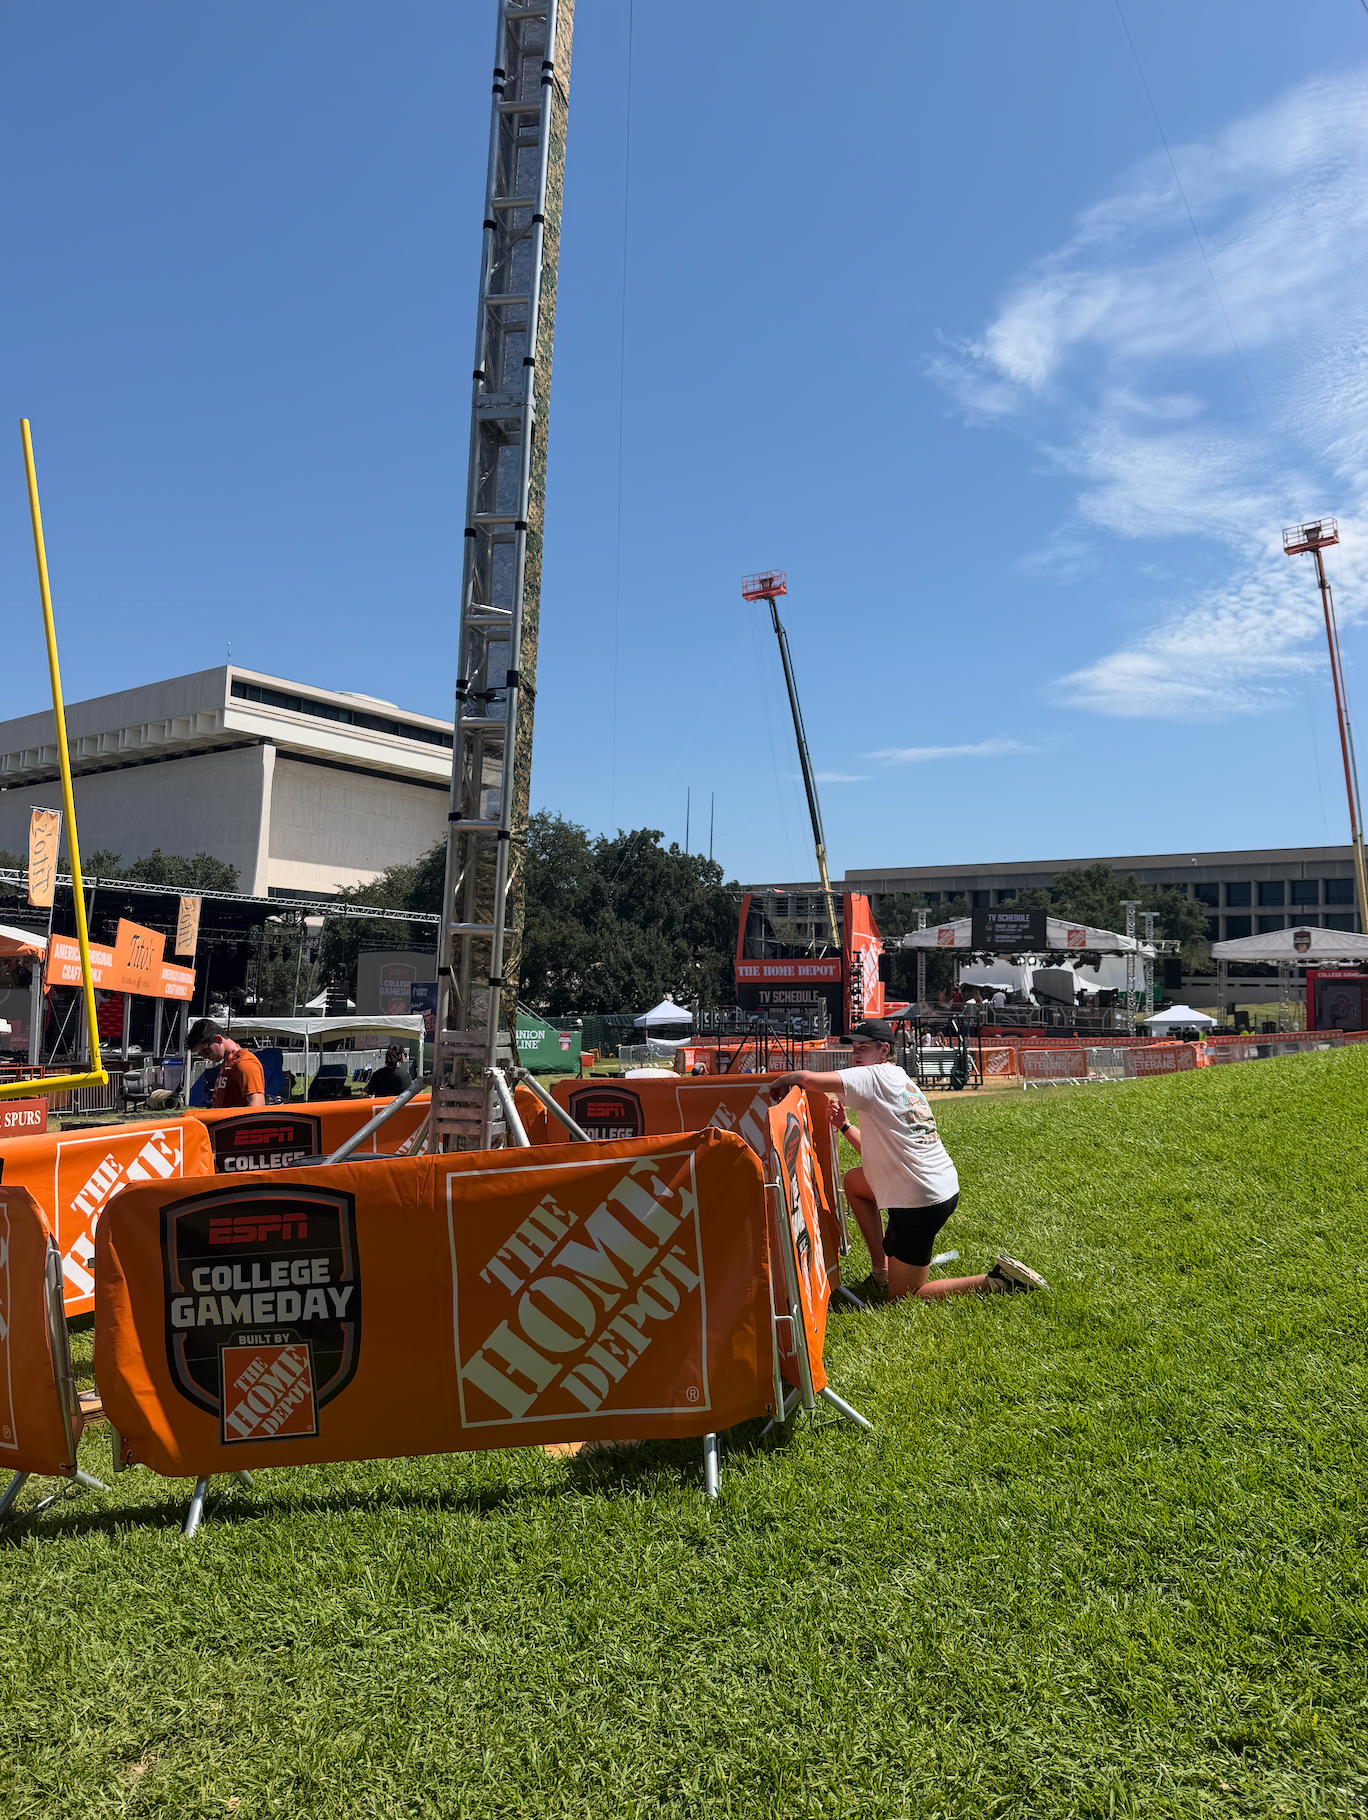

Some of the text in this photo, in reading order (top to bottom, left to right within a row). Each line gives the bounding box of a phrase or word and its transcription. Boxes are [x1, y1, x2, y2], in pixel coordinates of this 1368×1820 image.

[988, 914, 1030, 922] TV SCHEDULE
[127, 932, 154, 972] Tito's
[737, 965, 835, 977] THE HOME DEPOT
[379, 987, 411, 996] GAMEDA
[759, 990, 819, 1003] TV SCHEDULE
[1128, 1060, 1176, 1071] VETERANS
[1146, 1053, 1162, 1061] MORE
[1164, 1052, 1175, 1060] FOR
[4, 1110, 41, 1127] SPURS
[587, 1103, 625, 1117] ESPN
[234, 1127, 294, 1145] ESPN
[70, 1153, 124, 1217] THE
[209, 1213, 308, 1245] ESPN
[479, 1193, 580, 1296] THE
[192, 1258, 331, 1292] COLLEGE
[460, 1158, 695, 1420] HOME
[171, 1286, 354, 1328] GAMEDAY
[238, 1333, 290, 1345] BUILT BY
[559, 1244, 701, 1413] DEPOT
[233, 1357, 269, 1393] THE
[226, 1346, 310, 1438] HOME
[260, 1377, 312, 1436] DEPOT
